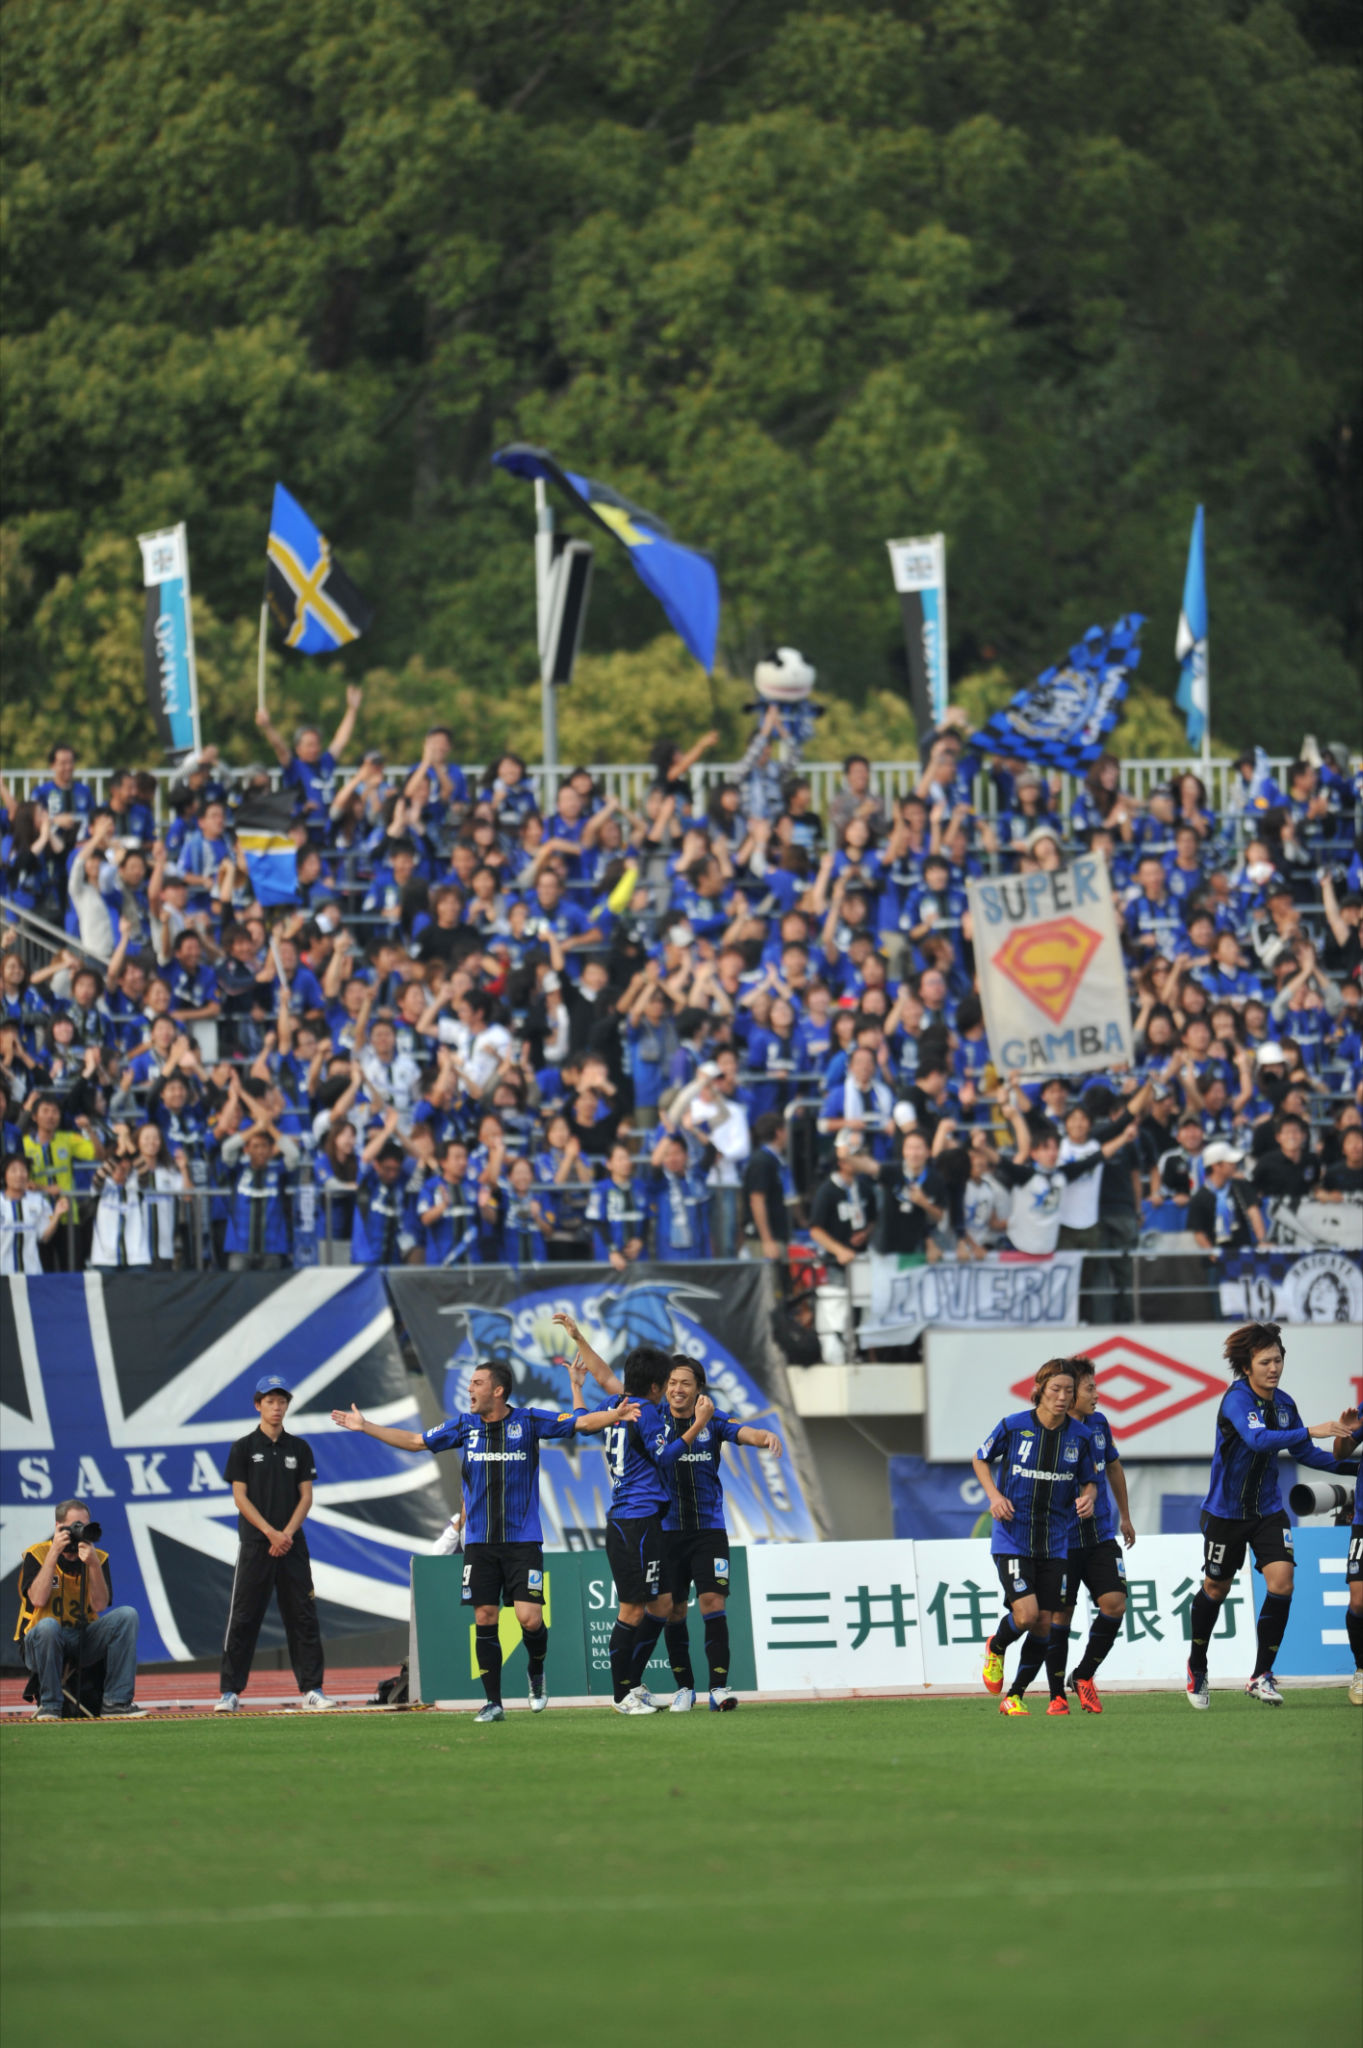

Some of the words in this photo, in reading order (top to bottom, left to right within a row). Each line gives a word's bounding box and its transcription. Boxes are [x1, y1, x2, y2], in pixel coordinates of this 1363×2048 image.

[979, 861, 1100, 924] SUPER
[1001, 1021, 1124, 1069] GAMBA
[467, 1450, 527, 1463] Panasonic
[1018, 1440, 1033, 1463] 4
[1012, 1464, 1074, 1482] Panasonic
[1207, 1541, 1226, 1564] 13
[462, 1564, 472, 1586] 9
[1008, 1559, 1020, 1579] 4
